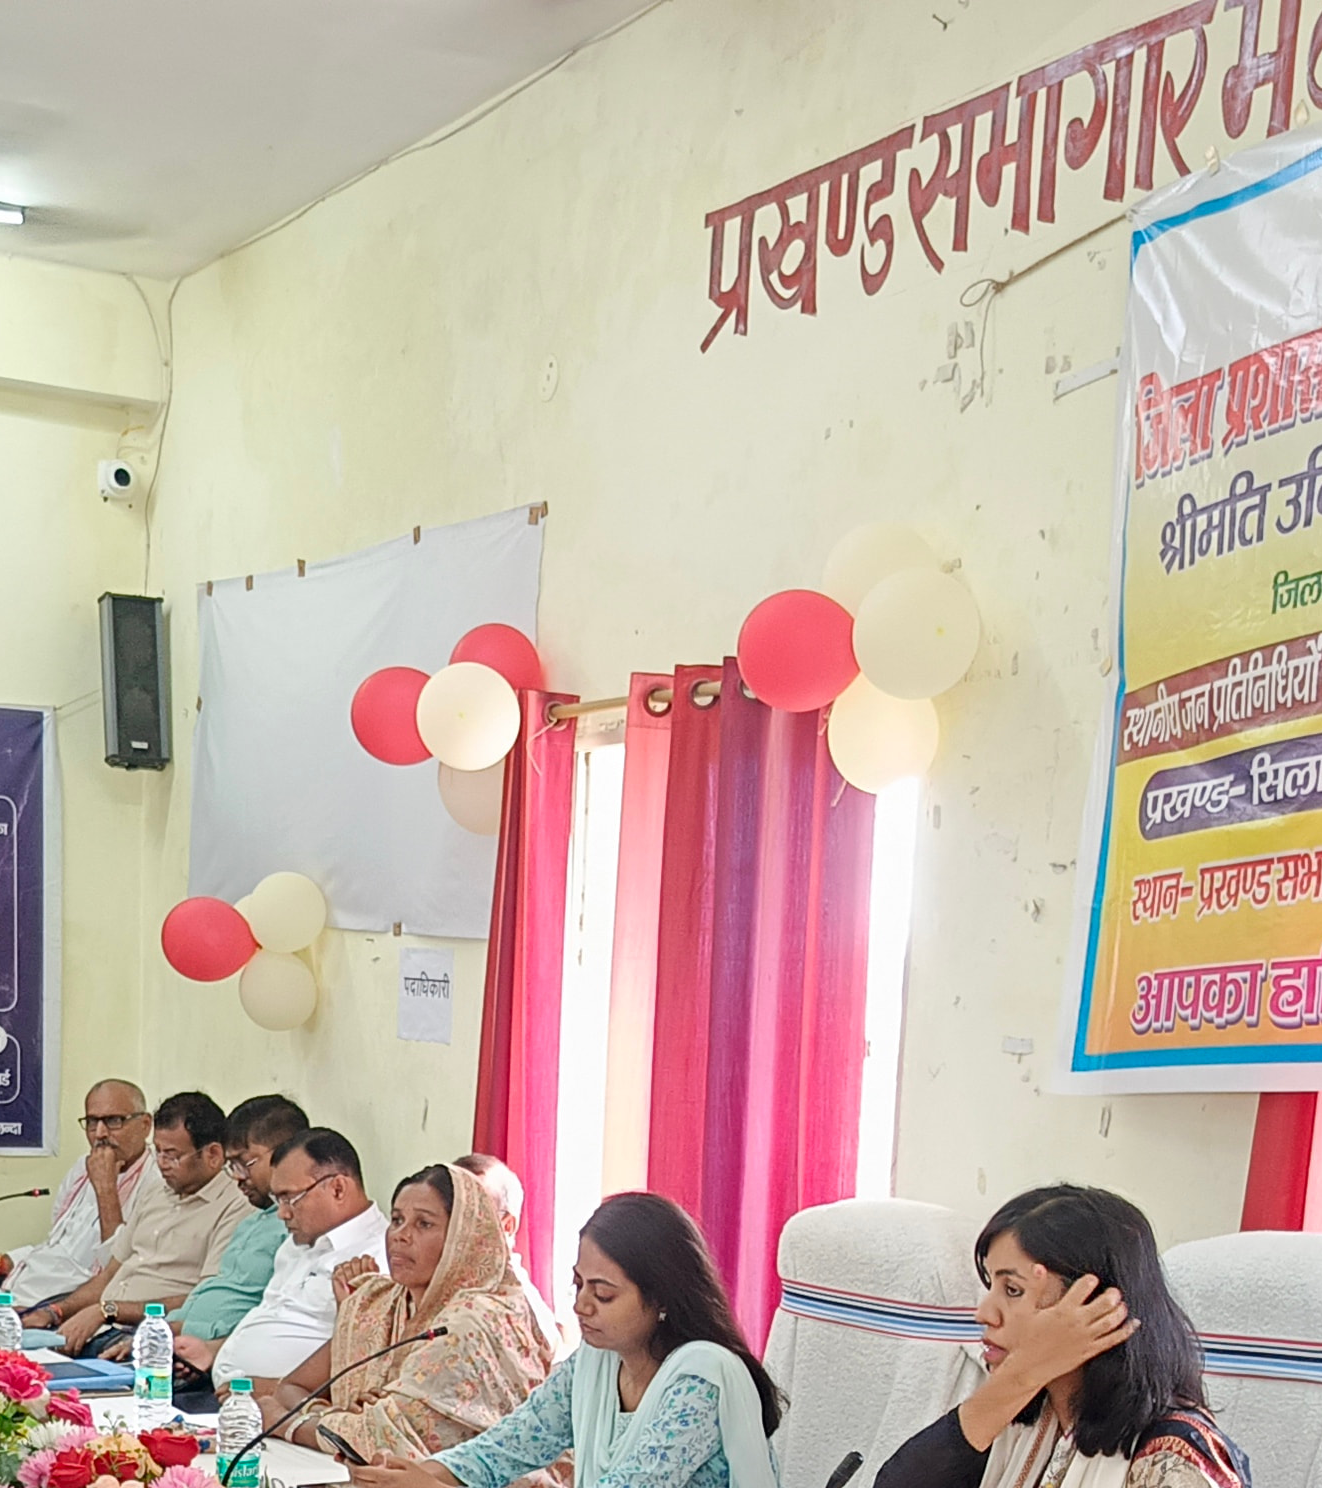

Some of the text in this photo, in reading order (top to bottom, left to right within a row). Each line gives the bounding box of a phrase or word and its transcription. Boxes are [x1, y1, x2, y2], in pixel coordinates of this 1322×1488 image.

[700, 123, 916, 354] प्रखण्ड
[1134, 371, 1225, 490] जिला
[1160, 470, 1272, 577] श्रीमति
[1123, 683, 1181, 750] स्थानीय
[1180, 683, 1212, 733] जन
[1146, 772, 1246, 831] प्रखण्ड-
[1131, 870, 1194, 923] स्थान-
[1196, 857, 1275, 919] प्रखण्ड
[404, 970, 450, 999] पदाधिकारी
[1130, 957, 1265, 1034] आपका
